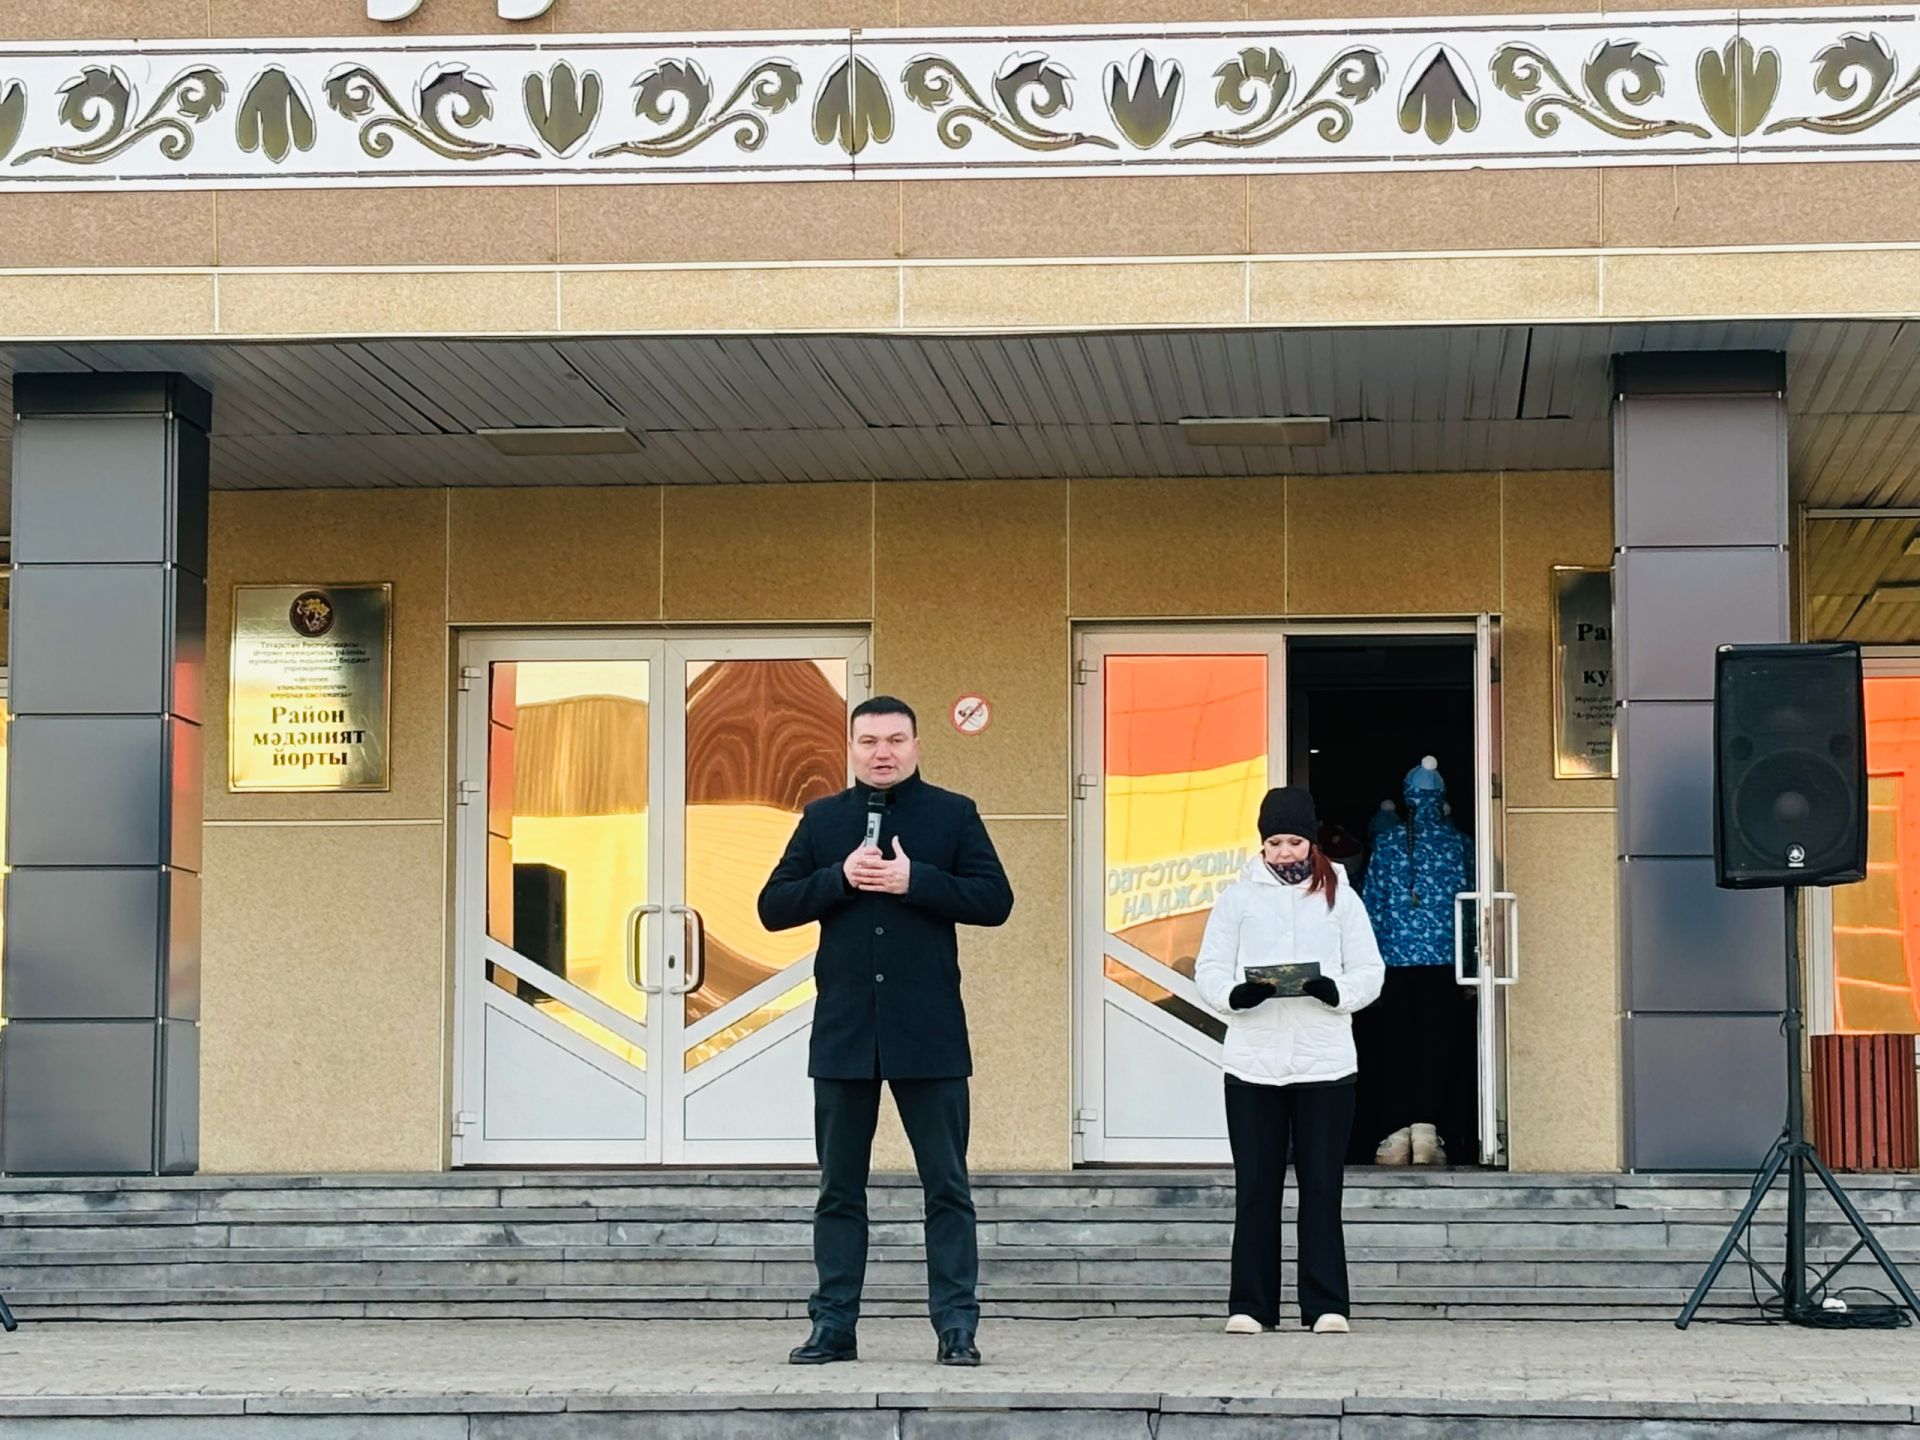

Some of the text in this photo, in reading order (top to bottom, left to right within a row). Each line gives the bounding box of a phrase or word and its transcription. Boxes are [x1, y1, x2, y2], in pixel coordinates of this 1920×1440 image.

[1583, 670, 1612, 687] ку
[272, 705, 345, 724] Район
[253, 730, 366, 747] мәдәният
[272, 748, 348, 769] йорты
